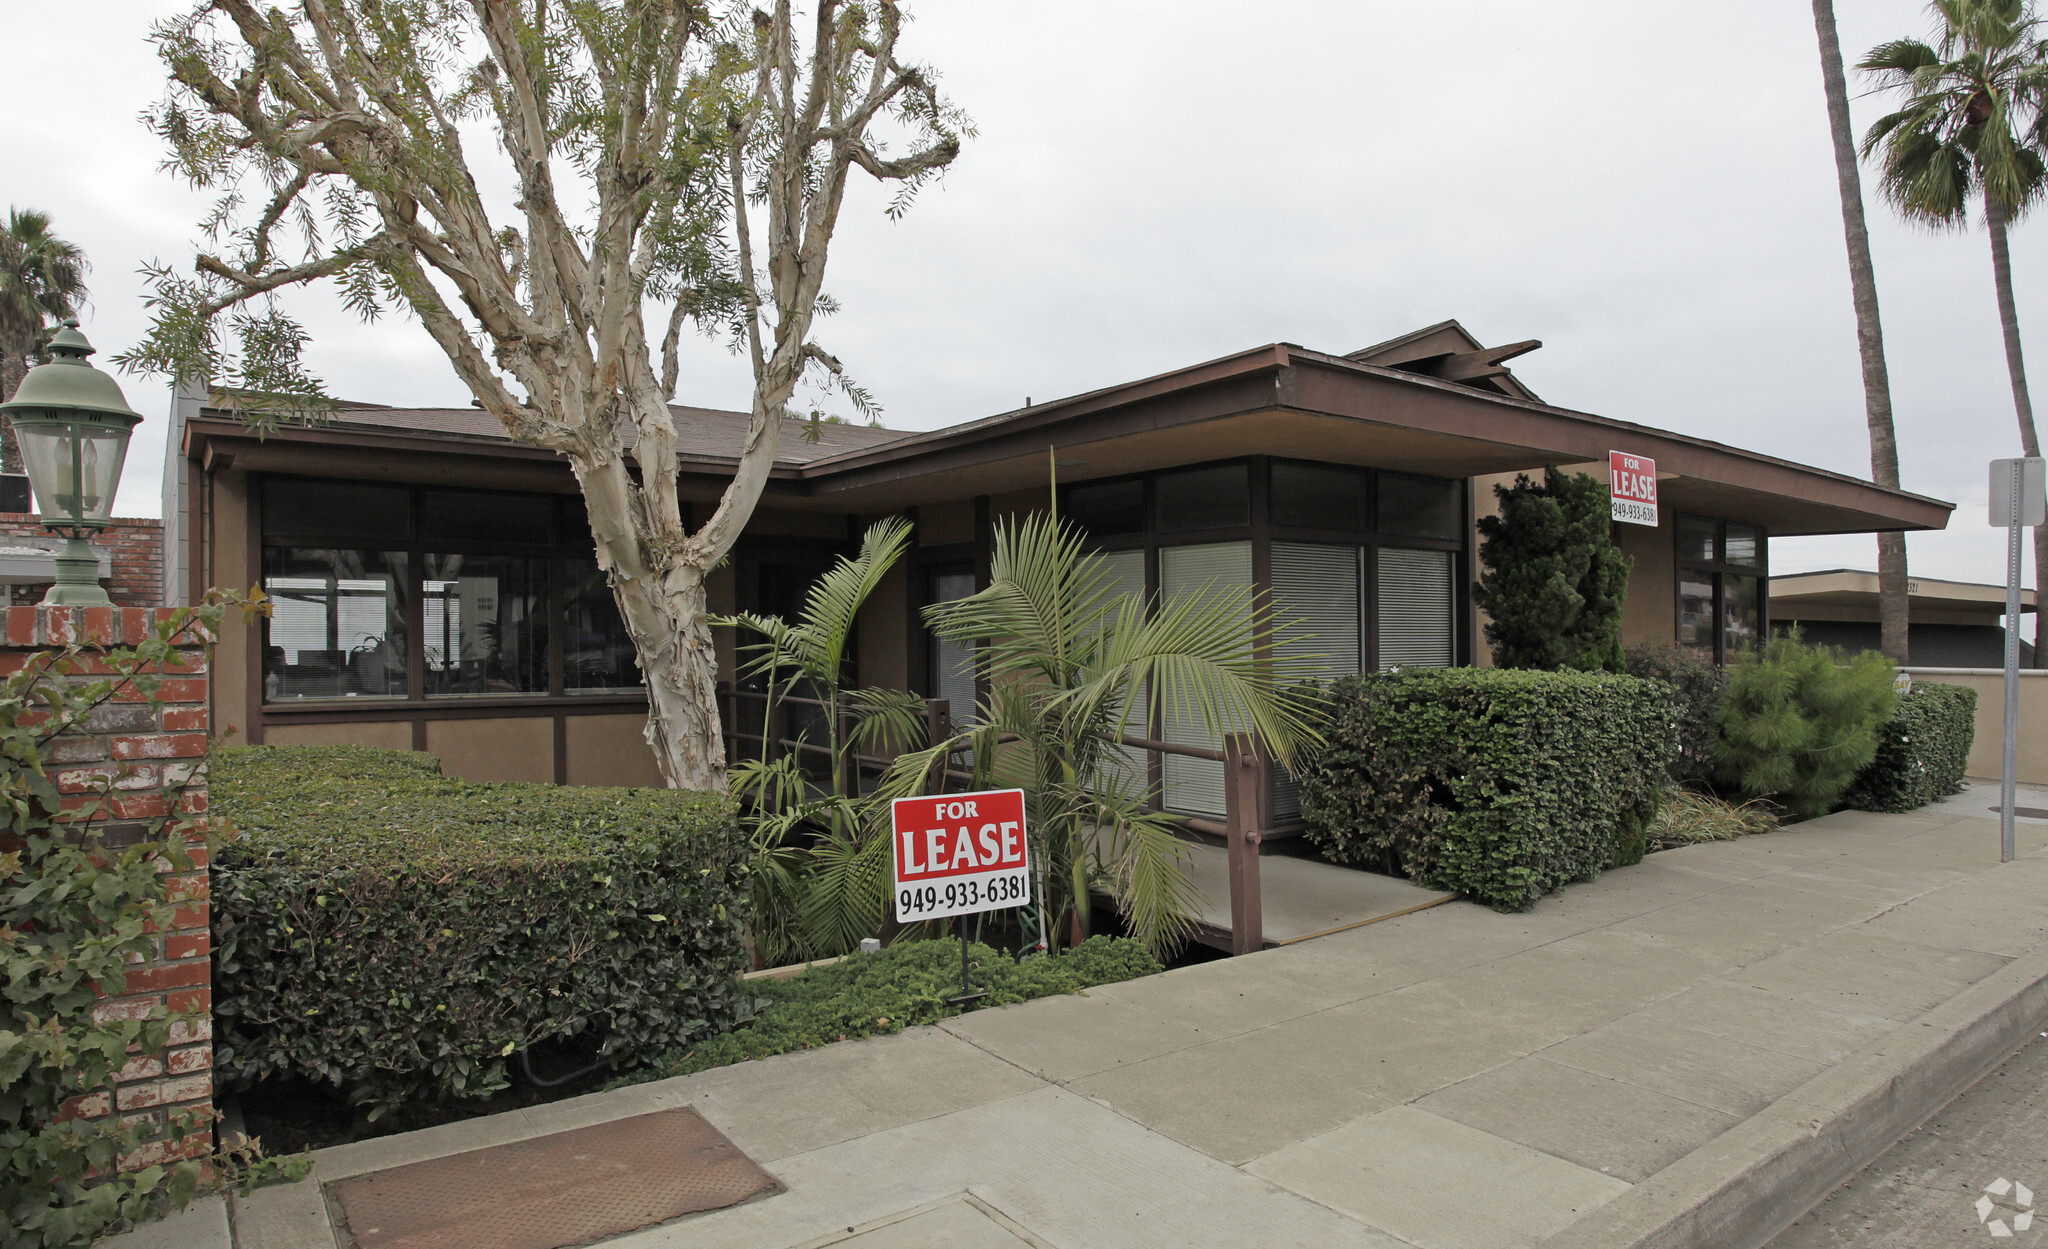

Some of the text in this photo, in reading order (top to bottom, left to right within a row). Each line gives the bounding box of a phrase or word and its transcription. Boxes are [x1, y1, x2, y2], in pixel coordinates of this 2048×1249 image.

[1624, 458, 1640, 470] FOR
[1613, 470, 1654, 501] LEASE
[1613, 502, 1656, 522] 949-933-6381
[935, 801, 979, 821] FOR
[902, 821, 1021, 875] LEASE
[900, 875, 1026, 915] 949-933-6381
